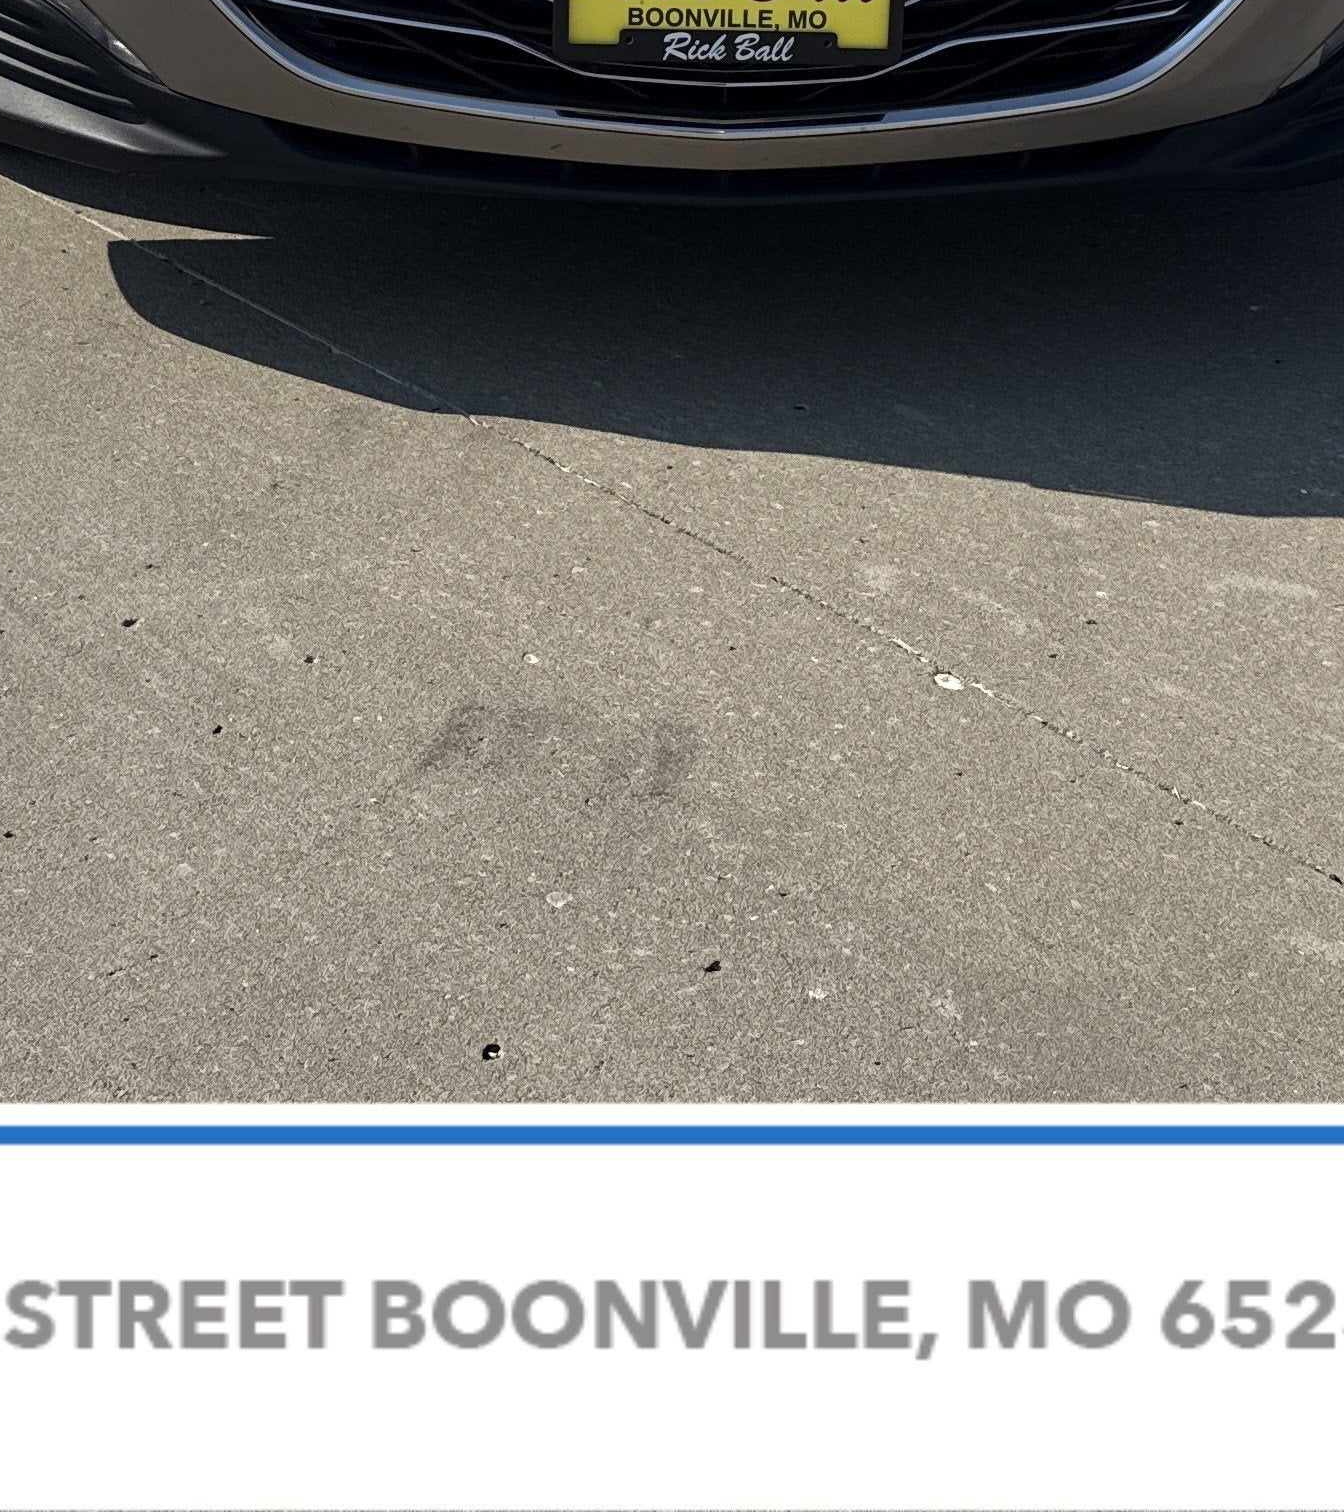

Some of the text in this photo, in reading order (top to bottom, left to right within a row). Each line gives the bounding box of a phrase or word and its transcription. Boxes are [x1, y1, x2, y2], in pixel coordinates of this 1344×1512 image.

[627, 6, 828, 31] BOONVILLE, MO
[662, 32, 795, 62] Rick Ball
